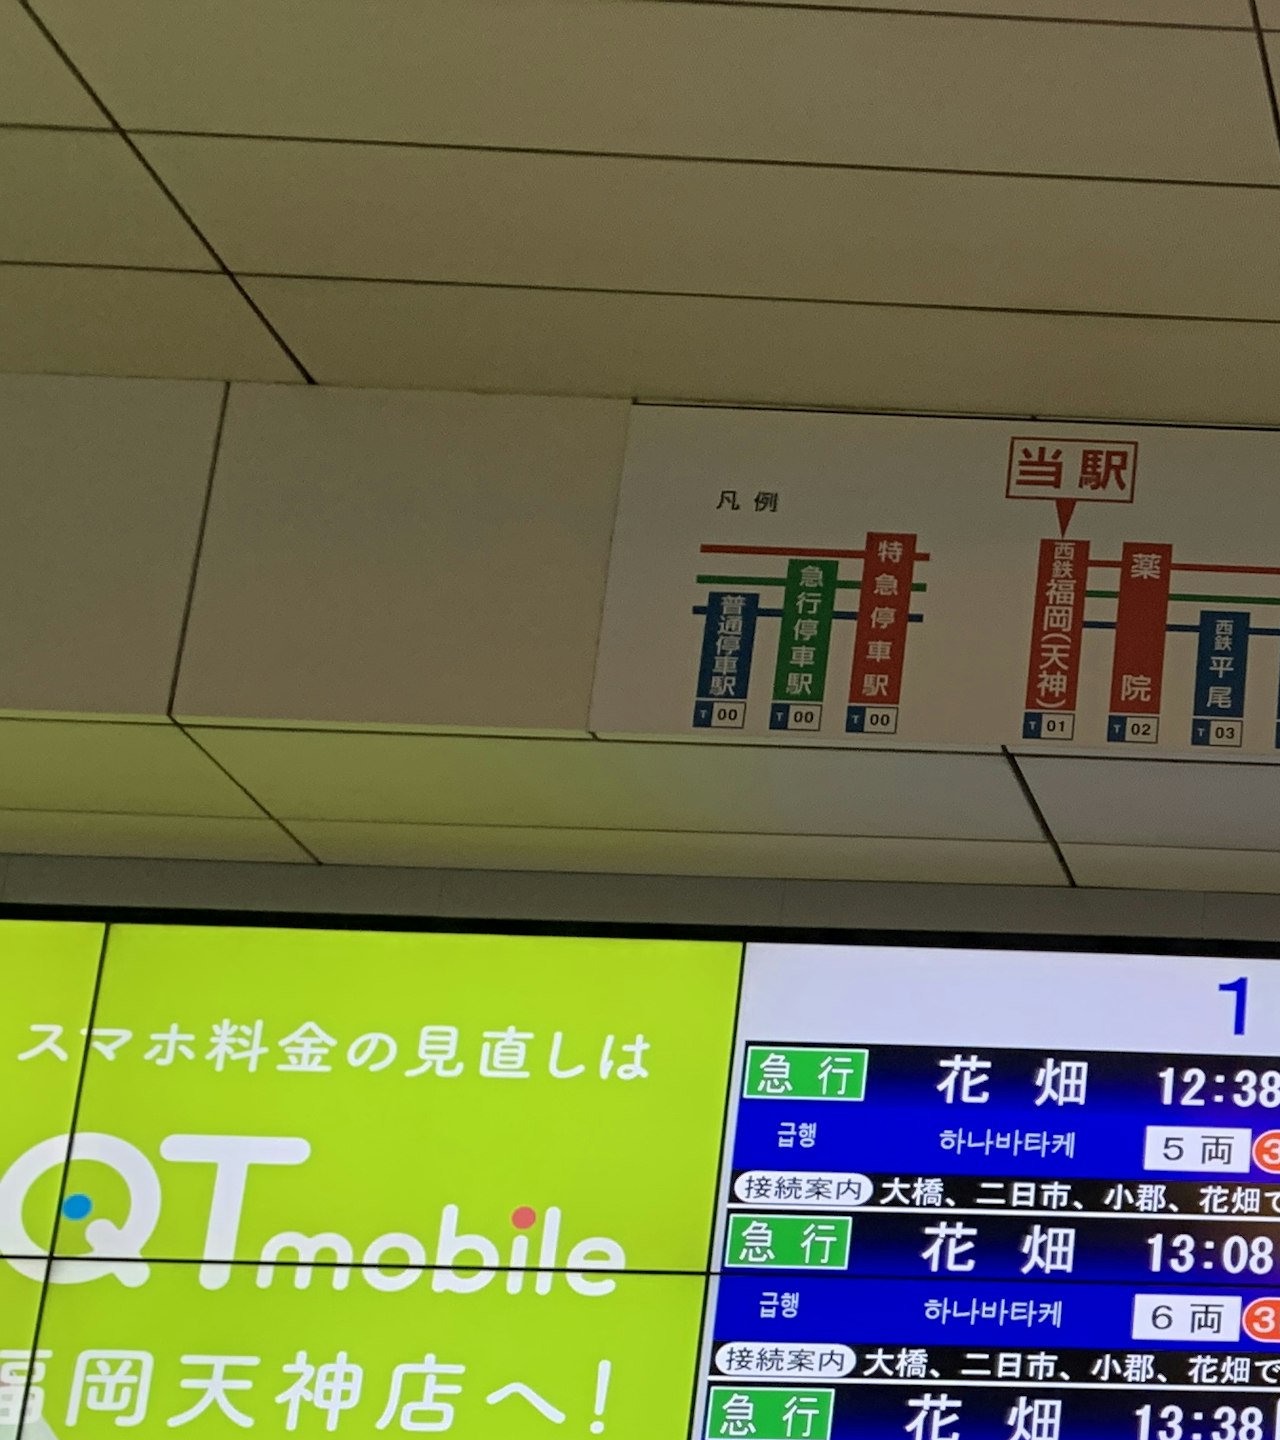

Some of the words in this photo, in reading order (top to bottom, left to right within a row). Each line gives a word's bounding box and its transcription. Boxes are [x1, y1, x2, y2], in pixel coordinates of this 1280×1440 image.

[1014, 446, 1127, 491] 当駅
[716, 490, 779, 512] 凡例
[785, 564, 825, 696] 急行停車駅
[861, 540, 905, 699] 特急停車駅
[1034, 541, 1076, 709] 西鉄福岡(天神)
[1120, 551, 1162, 702] 薬院
[708, 593, 748, 698] 普通停車駅
[1044, 719, 1067, 733] 01
[17, 1019, 651, 1081] スマホ料金の見直しは
[756, 1053, 855, 1097] 急行
[936, 1054, 1090, 1108] 花畑
[776, 1121, 818, 1148] 급행
[938, 1127, 1077, 1159] 하나바타케
[1161, 1135, 1236, 1166] 5両
[744, 1174, 864, 1202] 接続案内
[737, 1220, 839, 1265] 急行
[921, 1221, 1076, 1275] 花畑
[1146, 1234, 1275, 1275] 13:08
[923, 1296, 1064, 1329] 하나바타케
[1151, 1303, 1225, 1335] 6両
[723, 1346, 846, 1374] 接続案内
[719, 1393, 820, 1437] 急行
